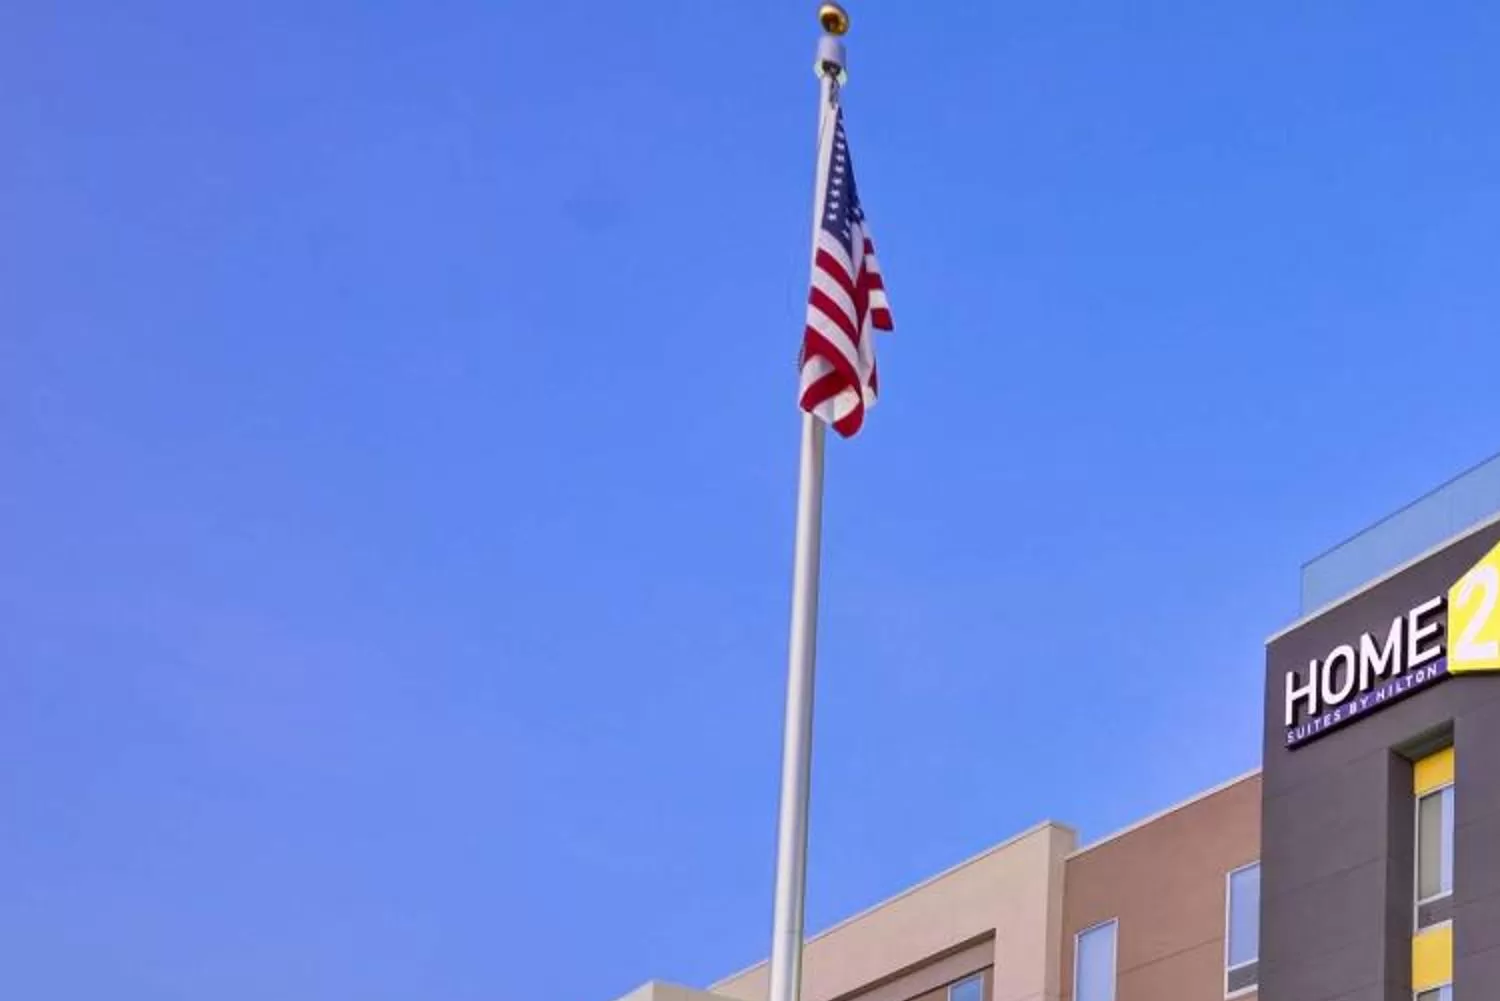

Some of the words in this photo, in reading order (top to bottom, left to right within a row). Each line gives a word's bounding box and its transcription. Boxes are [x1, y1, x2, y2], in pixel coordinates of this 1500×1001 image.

[1284, 595, 1443, 726] HOME
[1454, 562, 1500, 662] 2
[1287, 708, 1342, 743] SUITES
[1349, 696, 1370, 715] BY
[1375, 663, 1439, 701] HILTON
